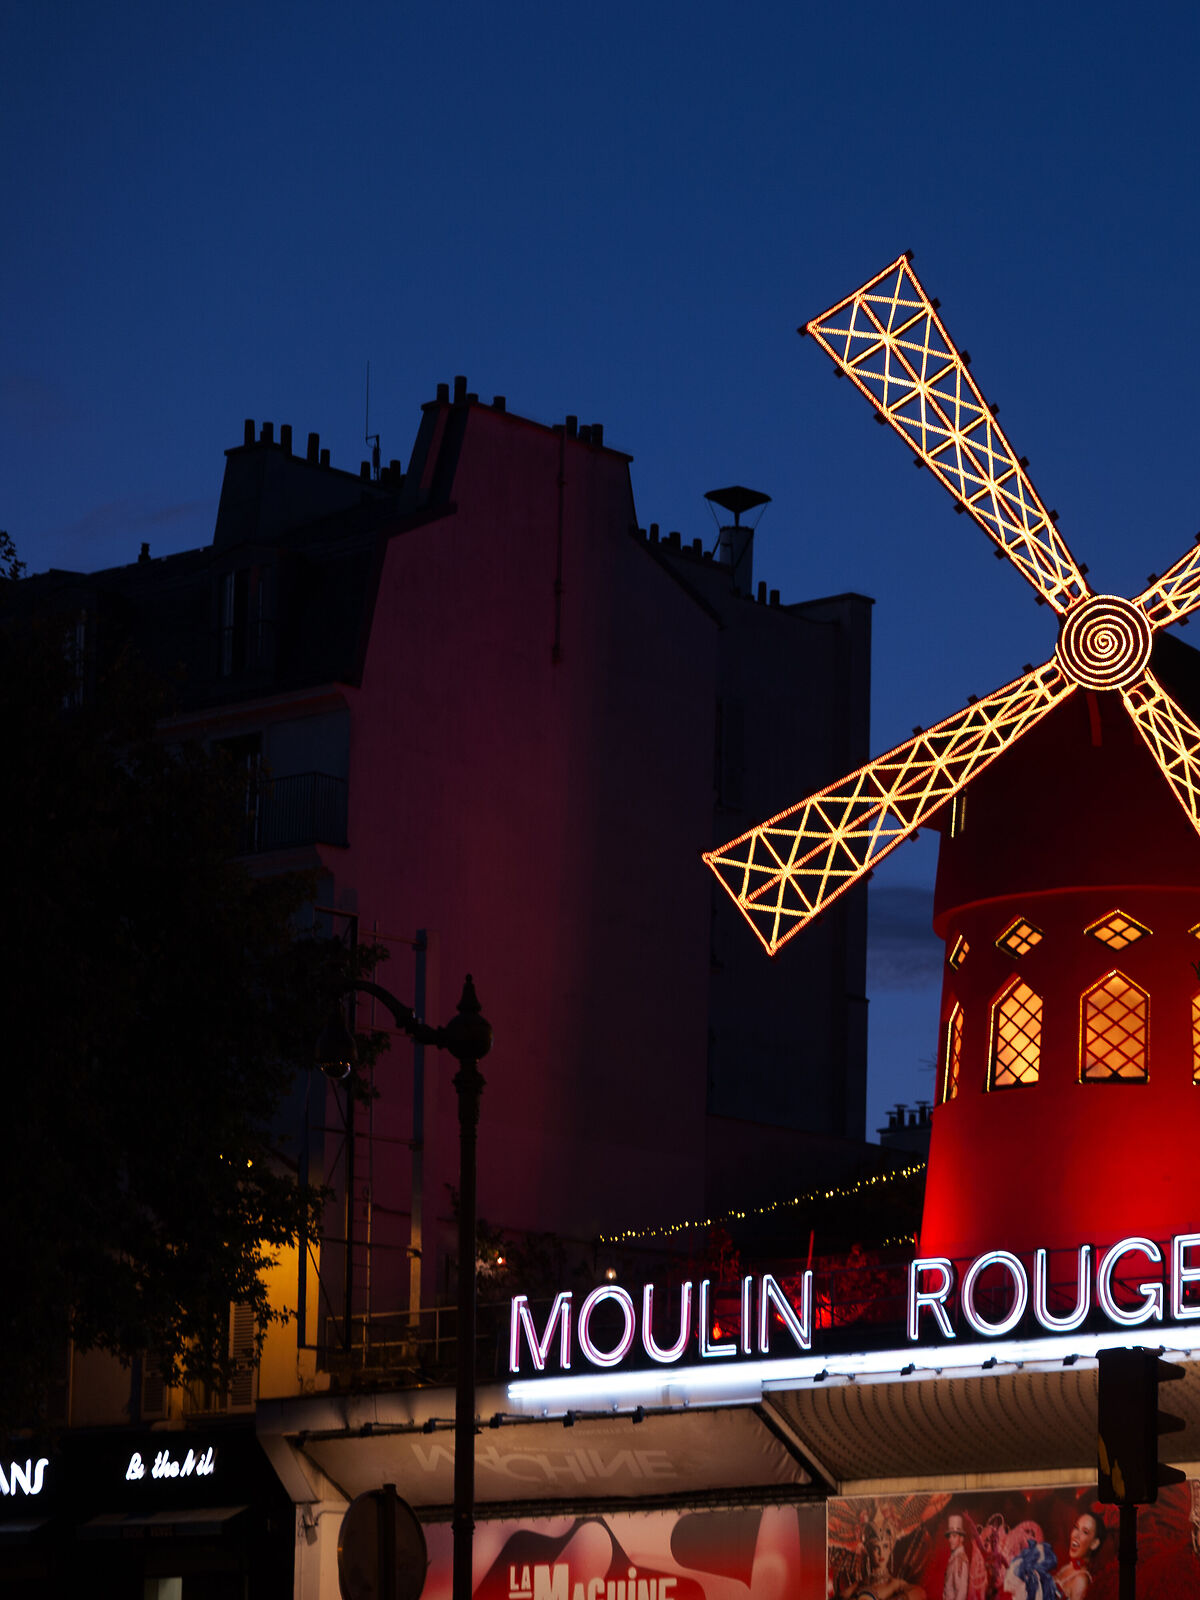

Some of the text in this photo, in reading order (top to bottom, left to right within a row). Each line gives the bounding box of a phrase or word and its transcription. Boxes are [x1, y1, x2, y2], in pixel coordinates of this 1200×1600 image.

[509, 1270, 813, 1372] MOULIN
[151, 1449, 180, 1479] the
[509, 1564, 532, 1590] LA
